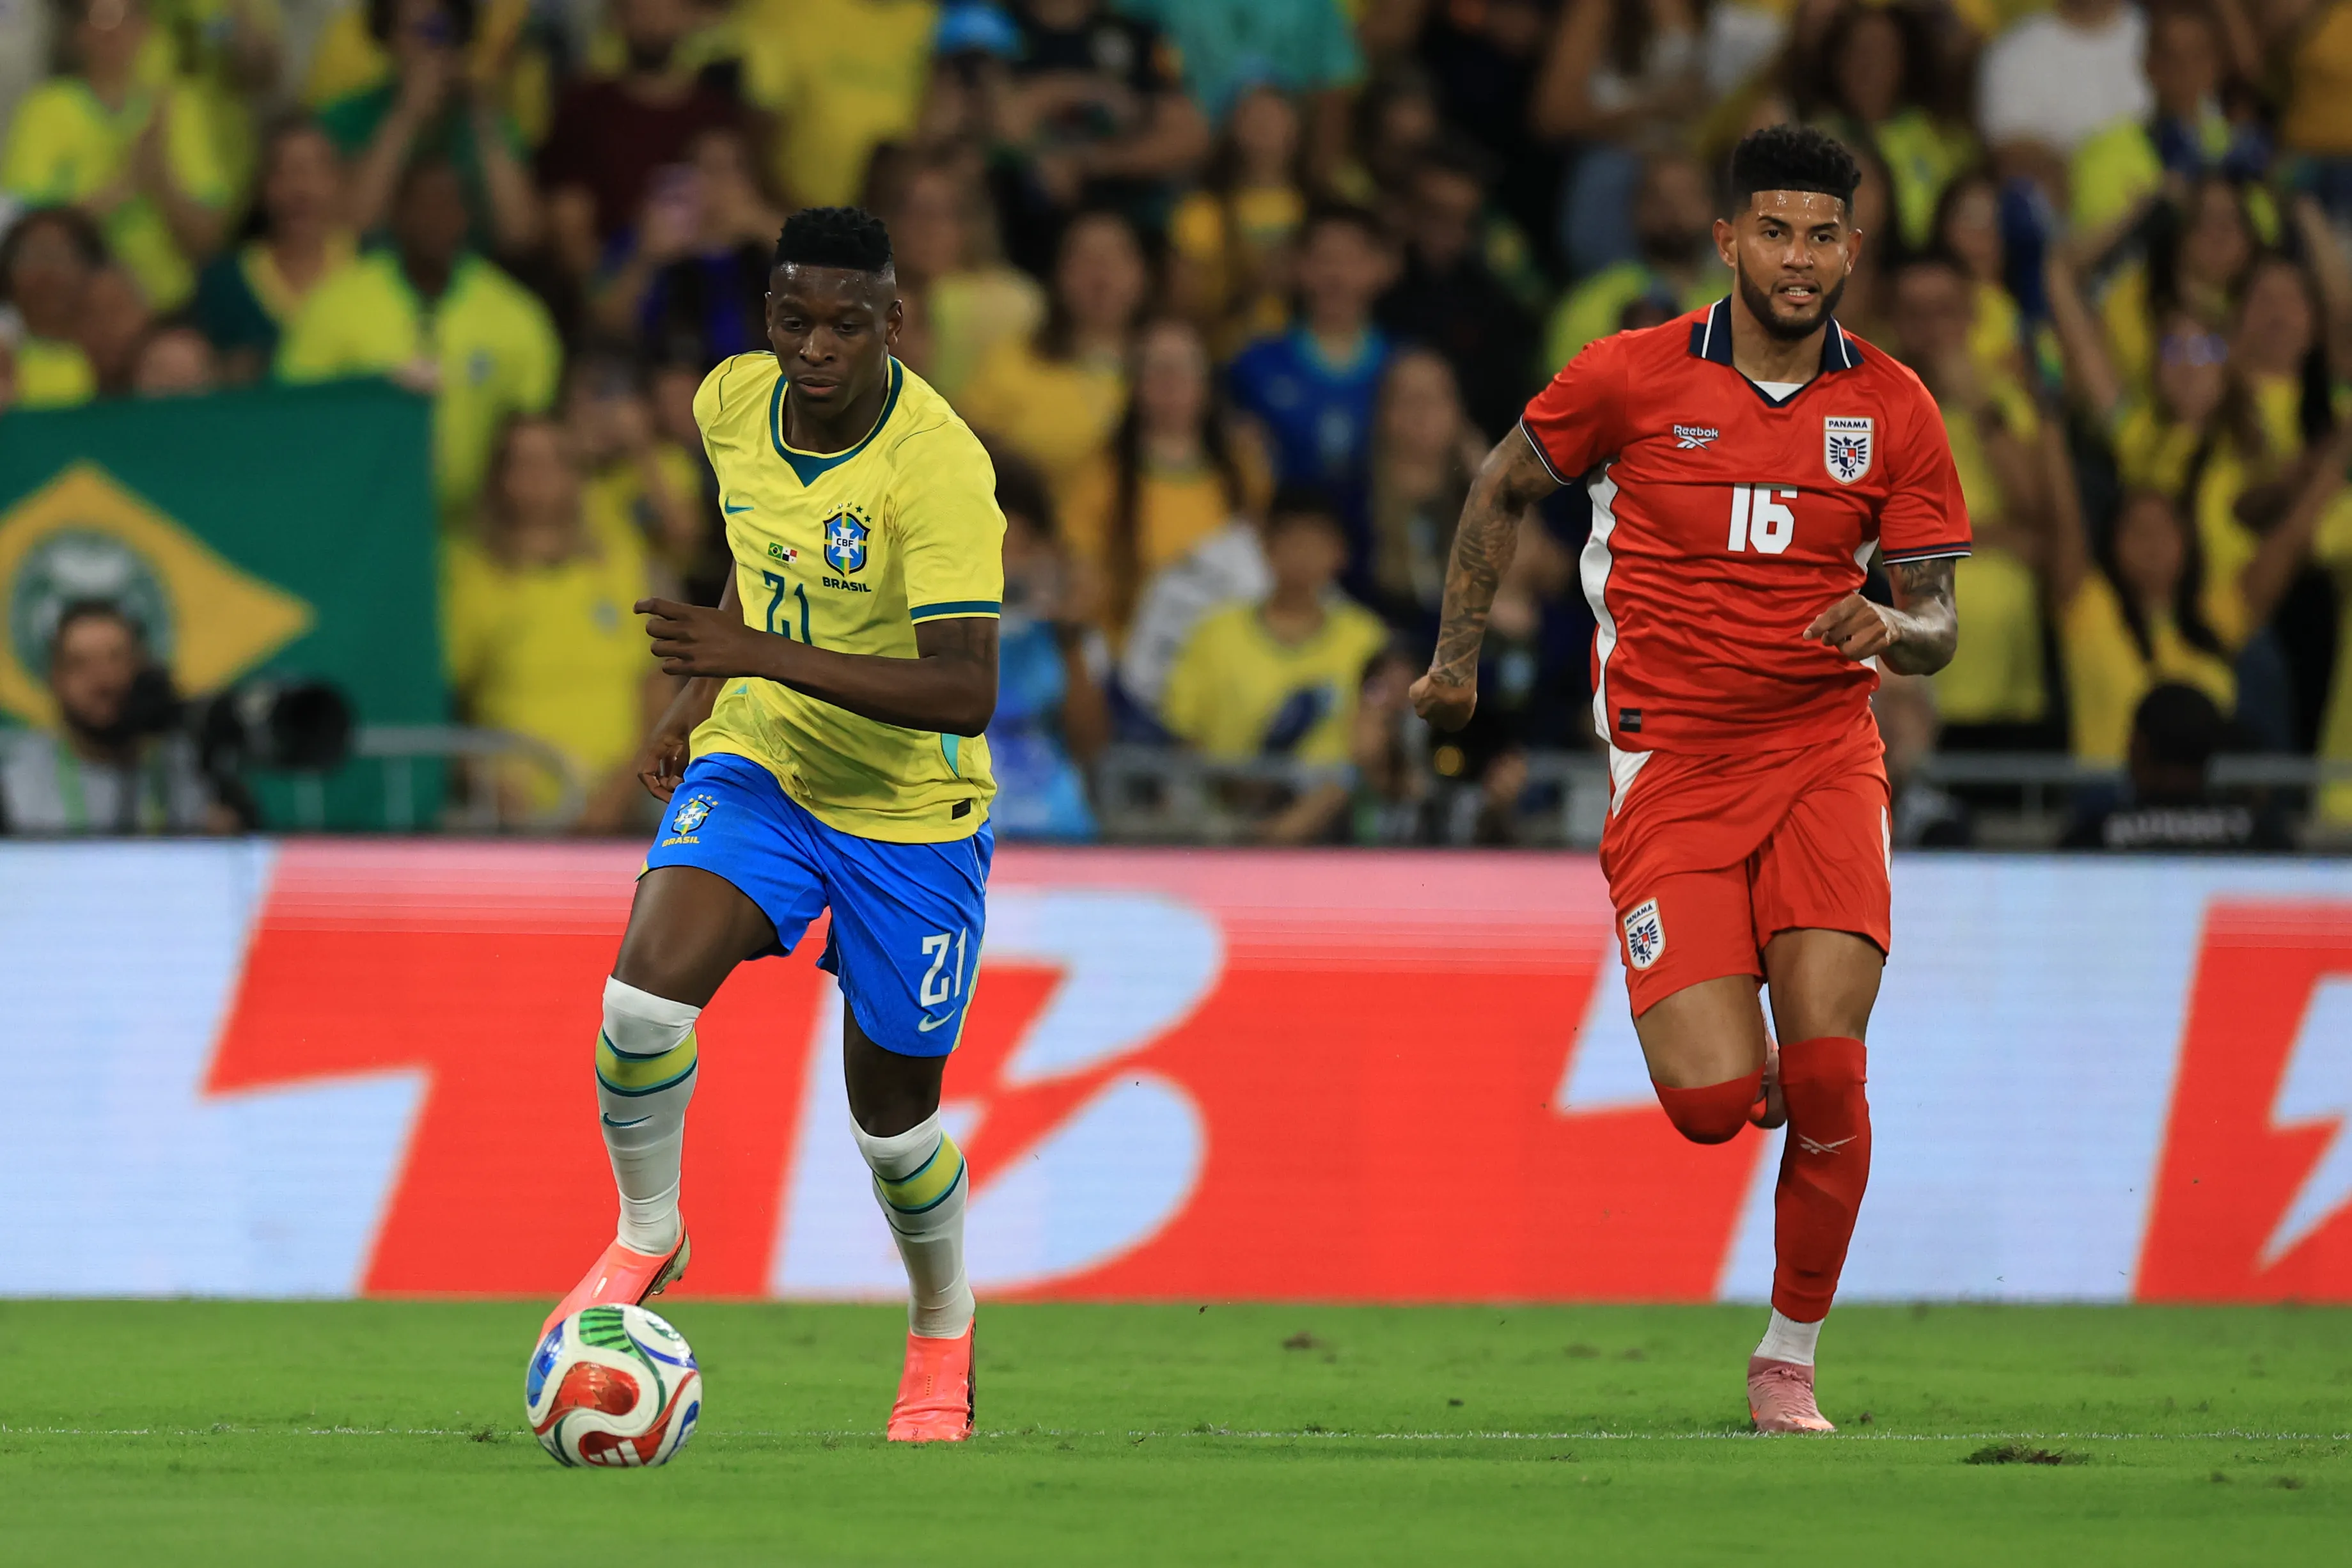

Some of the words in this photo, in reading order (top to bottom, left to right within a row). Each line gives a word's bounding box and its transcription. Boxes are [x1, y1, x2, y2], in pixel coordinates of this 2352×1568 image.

[1674, 424, 1719, 437] Reebok
[1727, 483, 1798, 554] 16
[836, 538, 854, 547] CBF
[822, 576, 872, 592] BRASIL
[762, 570, 812, 646] 21
[661, 836, 700, 847] BRASIL
[920, 927, 967, 1007] 21
